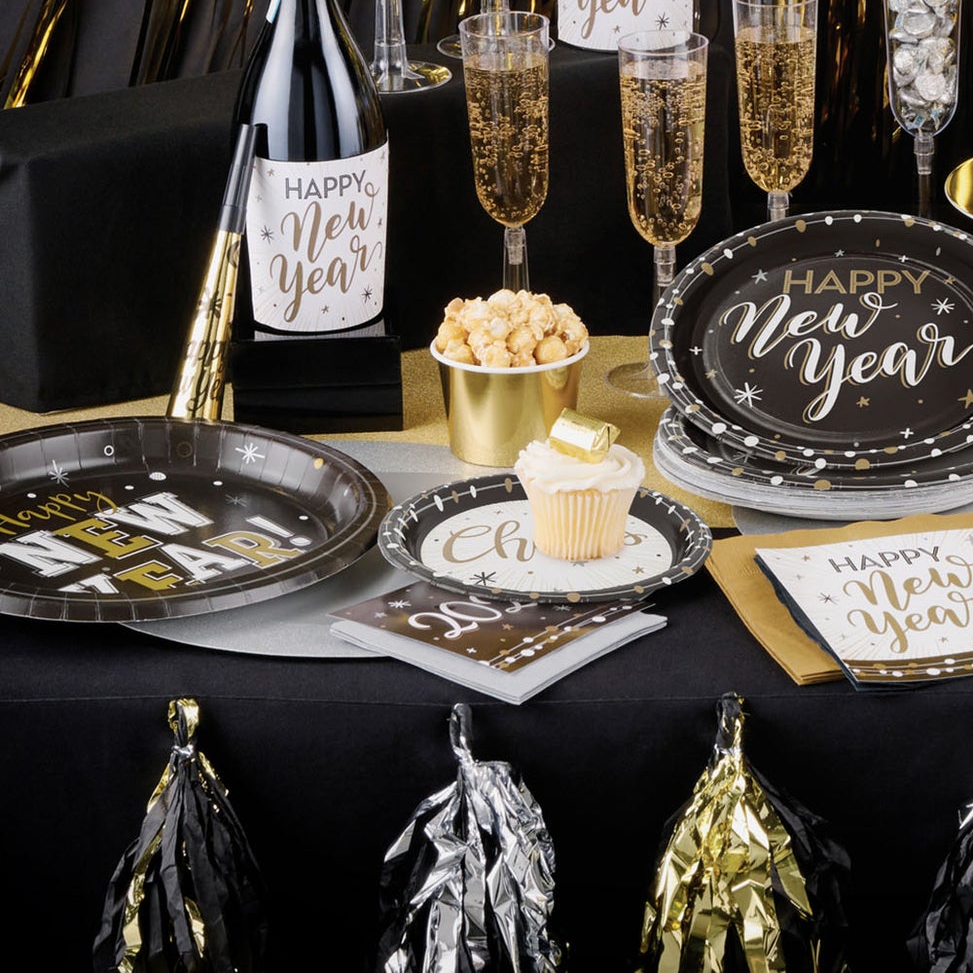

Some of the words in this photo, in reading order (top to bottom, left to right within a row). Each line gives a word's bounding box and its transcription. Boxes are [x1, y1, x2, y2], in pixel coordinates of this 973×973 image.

[285, 170, 366, 199] HAPPY
[281, 182, 380, 263] New
[270, 235, 382, 323] Year
[782, 270, 931, 294] HAPPY
[719, 292, 898, 359] New
[0, 488, 118, 535] Happy
[0, 491, 214, 577] NEW
[828, 545, 941, 574] HAPPY
